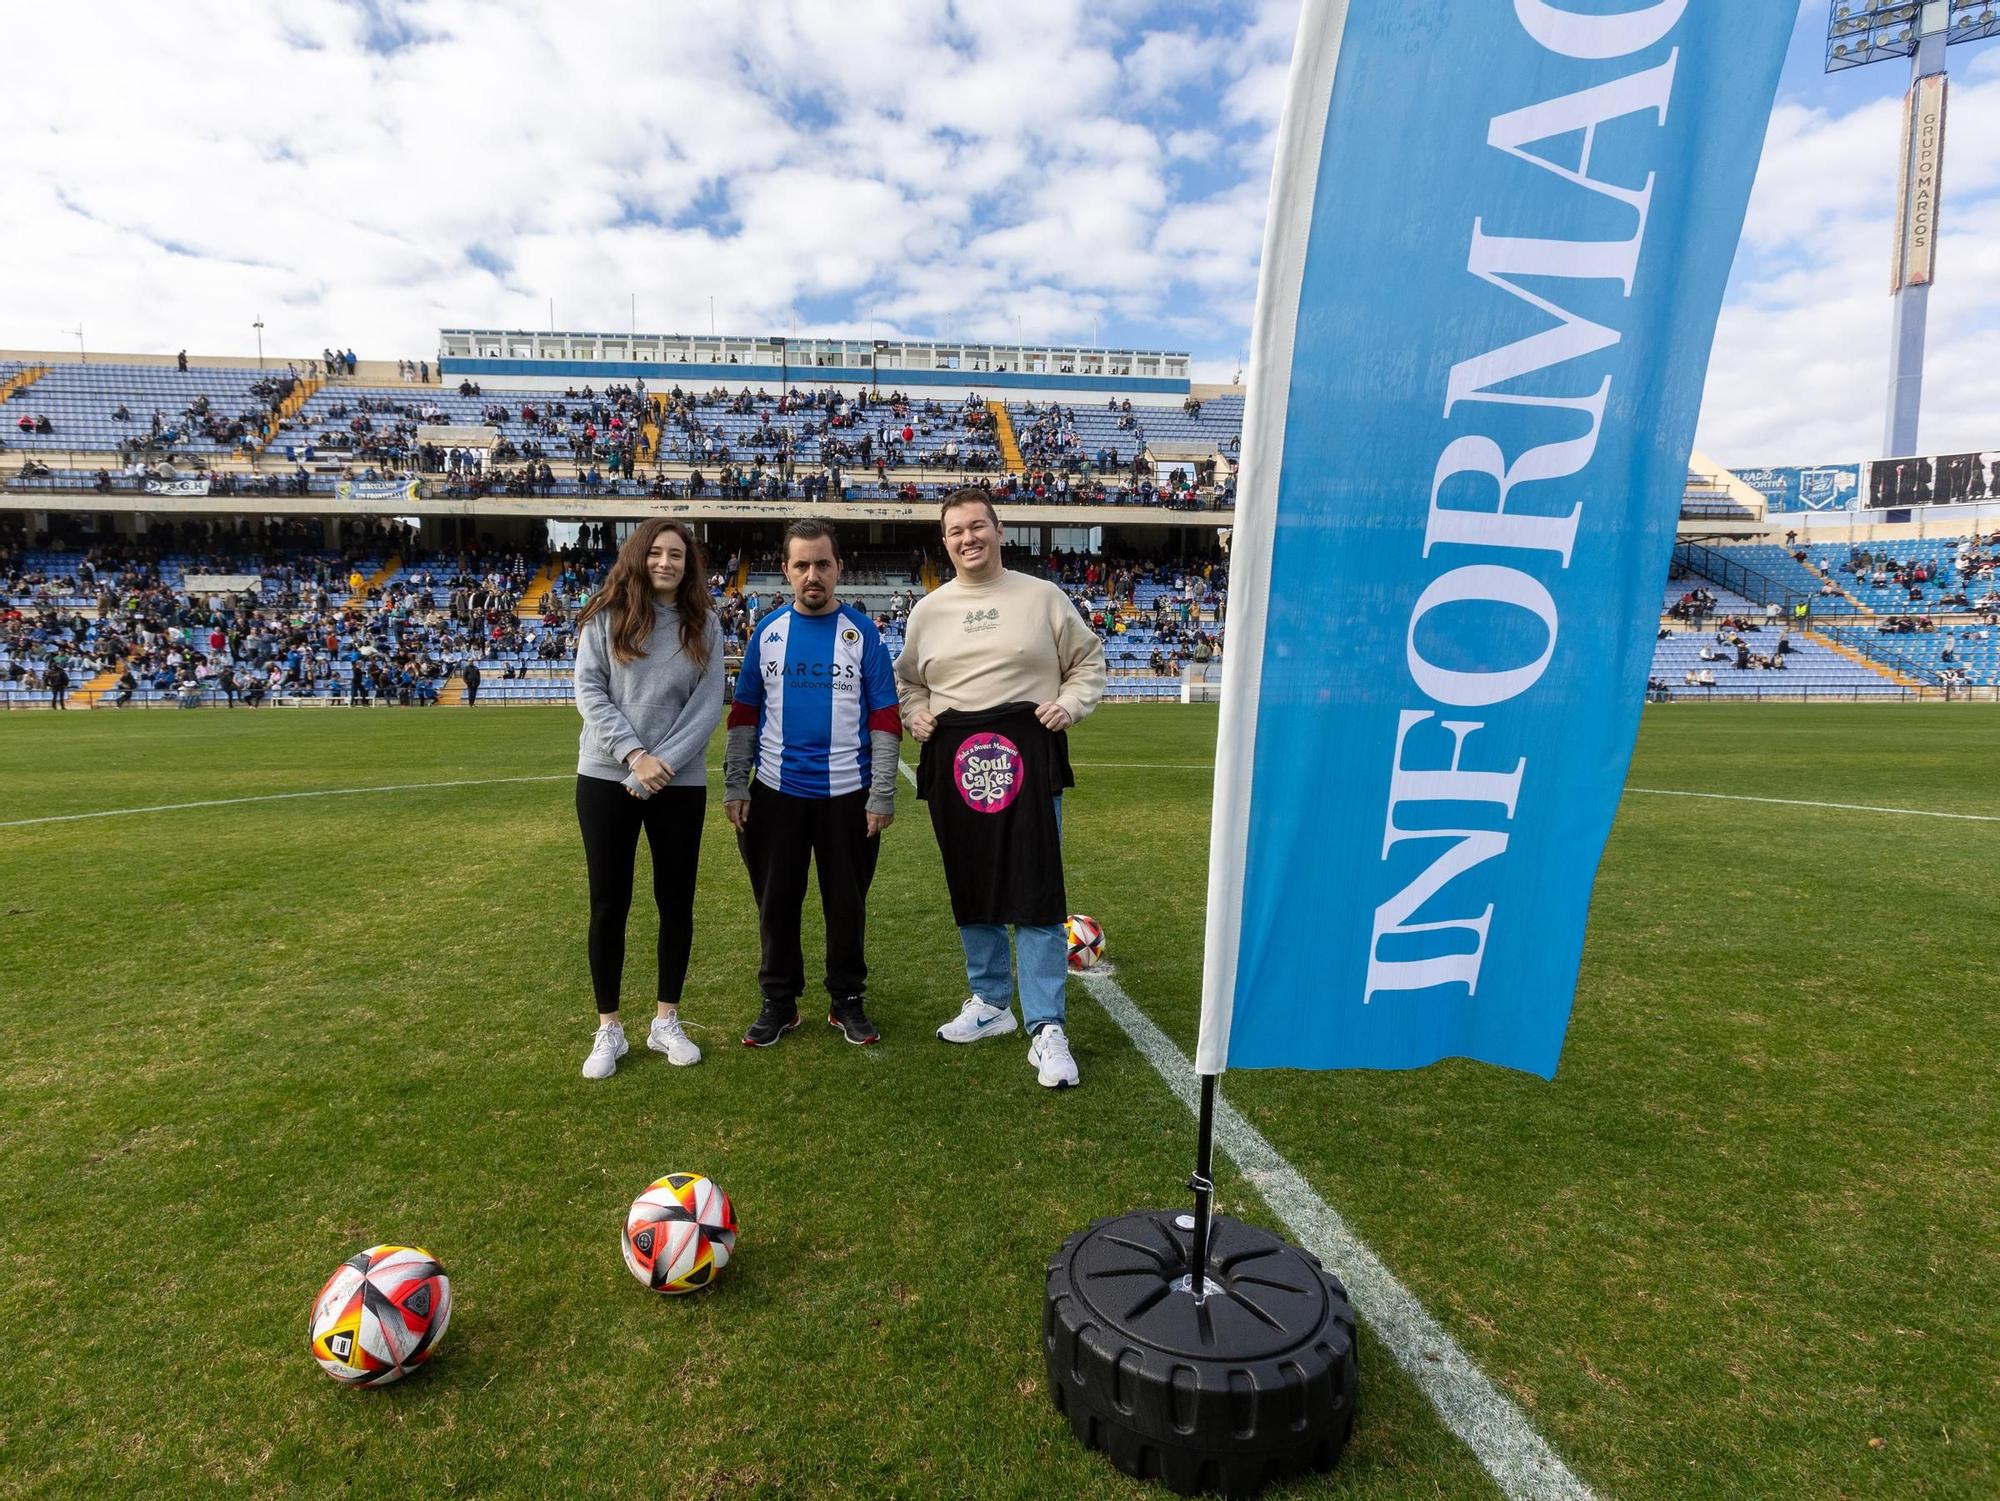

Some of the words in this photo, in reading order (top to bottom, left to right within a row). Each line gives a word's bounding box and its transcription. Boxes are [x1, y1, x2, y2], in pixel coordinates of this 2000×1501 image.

[765, 661, 855, 679] MARCOS
[968, 754, 1012, 774] Soul
[962, 771, 1014, 804] Cakes
